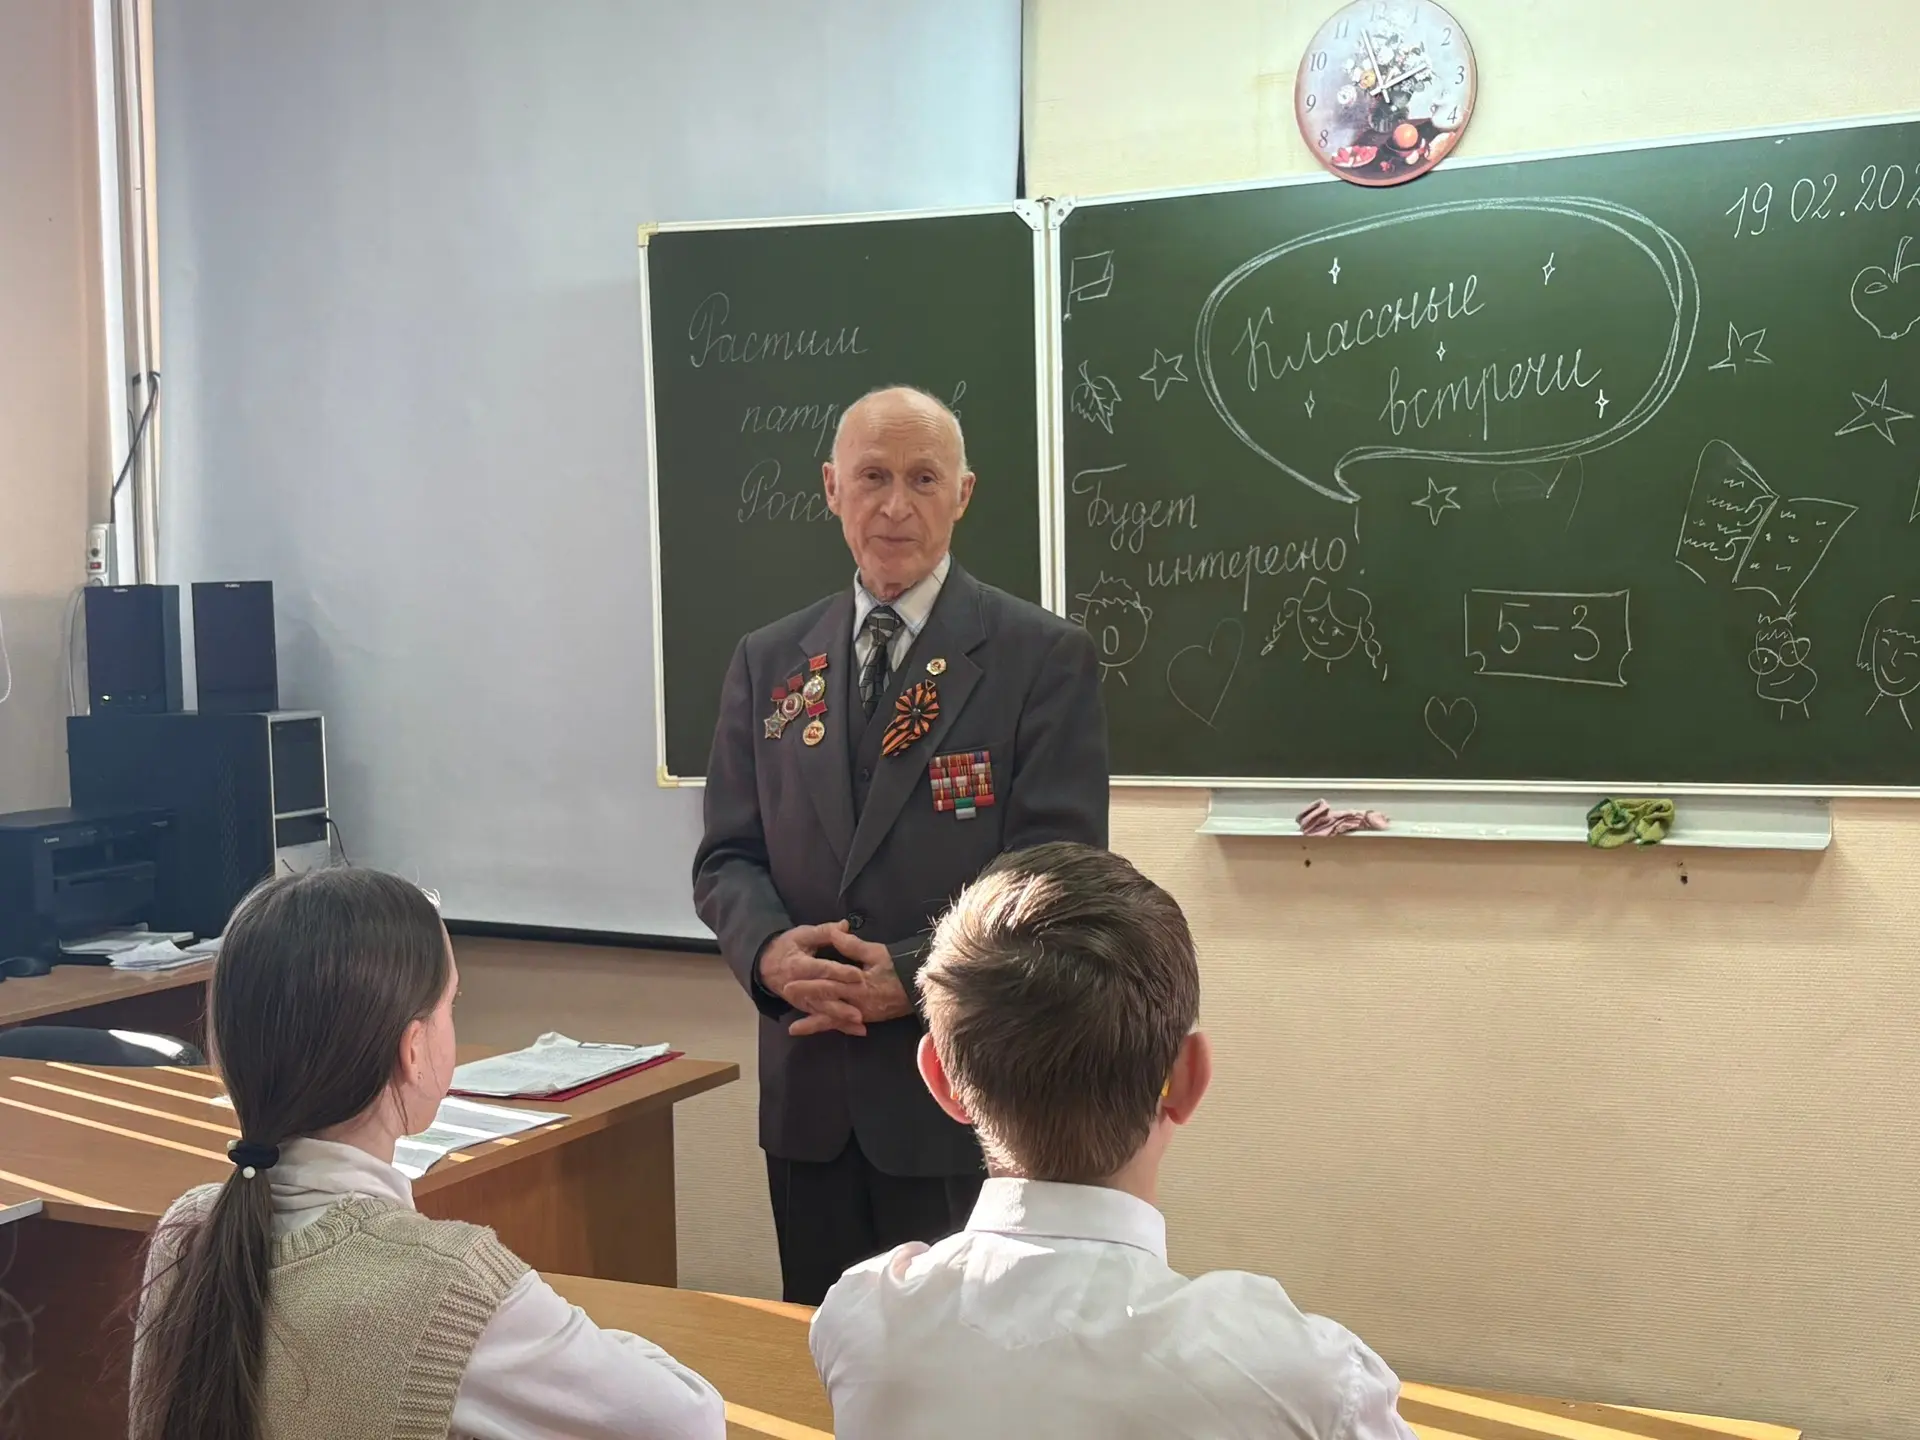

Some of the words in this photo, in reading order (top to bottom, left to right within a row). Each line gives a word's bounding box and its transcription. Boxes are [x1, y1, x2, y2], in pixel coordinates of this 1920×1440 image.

[1334, 20, 1349, 39] 11
[1441, 27, 1452, 46] 2
[1311, 52, 1327, 72] 10
[1455, 66, 1465, 84] 3
[1306, 94, 1316, 113] 9
[1447, 105, 1458, 124] 4
[1318, 129, 1328, 148] 8
[689, 292, 869, 368] Растим
[1232, 275, 1485, 391] Классные
[1379, 349, 1602, 440] встречи
[740, 380, 967, 457] патрв
[1071, 463, 1198, 553] Будет
